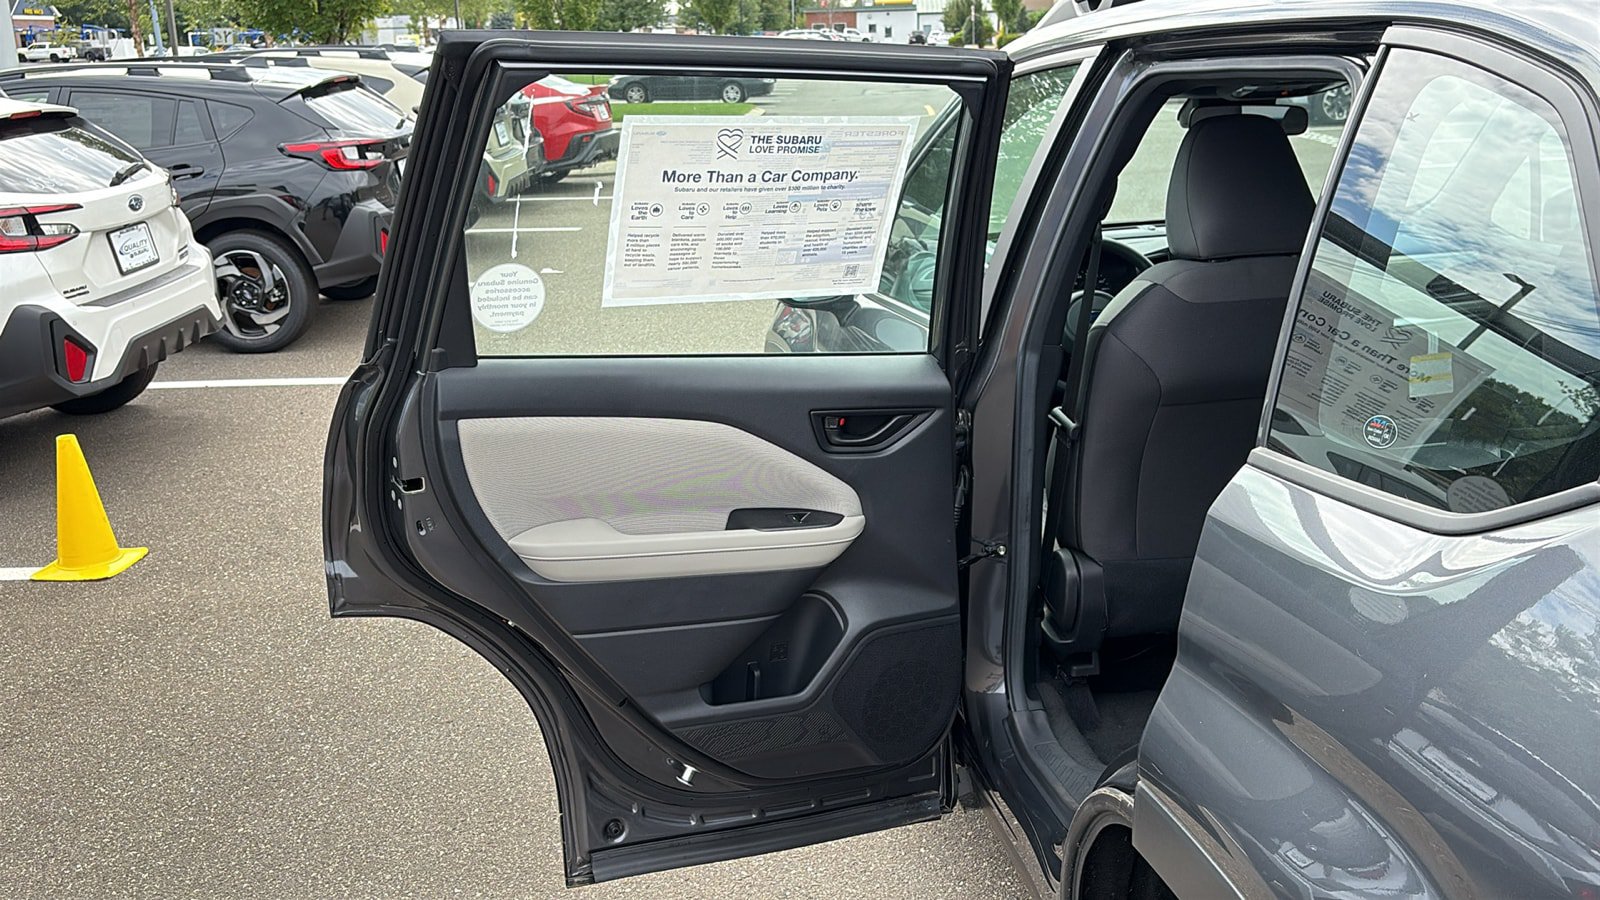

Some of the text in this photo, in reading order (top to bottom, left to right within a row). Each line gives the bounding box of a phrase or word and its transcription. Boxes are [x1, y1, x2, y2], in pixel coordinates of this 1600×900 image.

[751, 136, 822, 144] THE SUBARU
[749, 146, 820, 154] LOVE PROMISE
[662, 170, 858, 184] More Than a Car Company.
[758, 186, 774, 194] given
[826, 184, 846, 192] charity.
[124, 239, 147, 251] QUALITY
